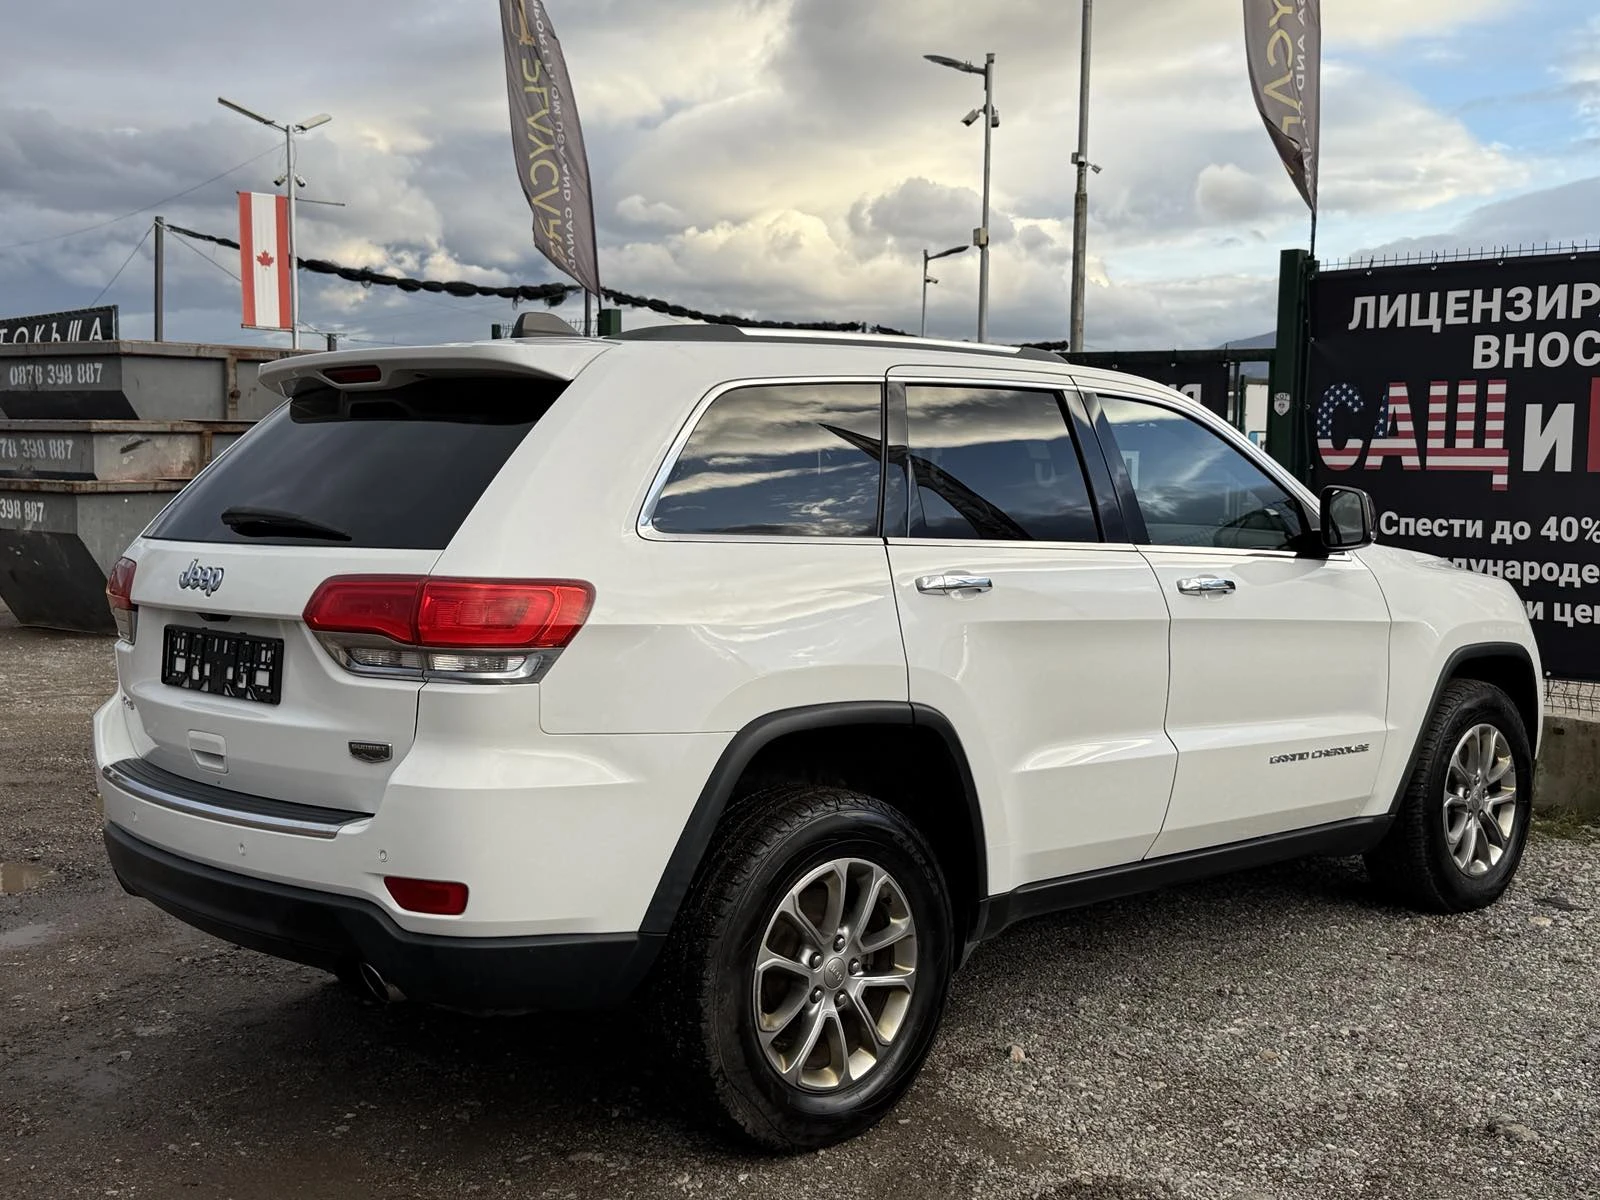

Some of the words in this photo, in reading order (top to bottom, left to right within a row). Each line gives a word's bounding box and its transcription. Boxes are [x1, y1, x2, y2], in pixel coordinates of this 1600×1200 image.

[1472, 330, 1600, 369] ВНОС
[10, 364, 43, 385] 0878
[47, 363, 73, 384] 398
[77, 362, 103, 384] 887
[20, 439, 46, 458] 398
[49, 439, 74, 459] 887
[1316, 379, 1509, 491] САЩ
[0, 498, 21, 519] 398
[24, 501, 44, 522] 887
[1379, 510, 1483, 538] Спести
[1490, 520, 1532, 545] до
[1539, 516, 1600, 544] 40%
[179, 558, 224, 597] Jeep
[1269, 751, 1309, 764] GRAND
